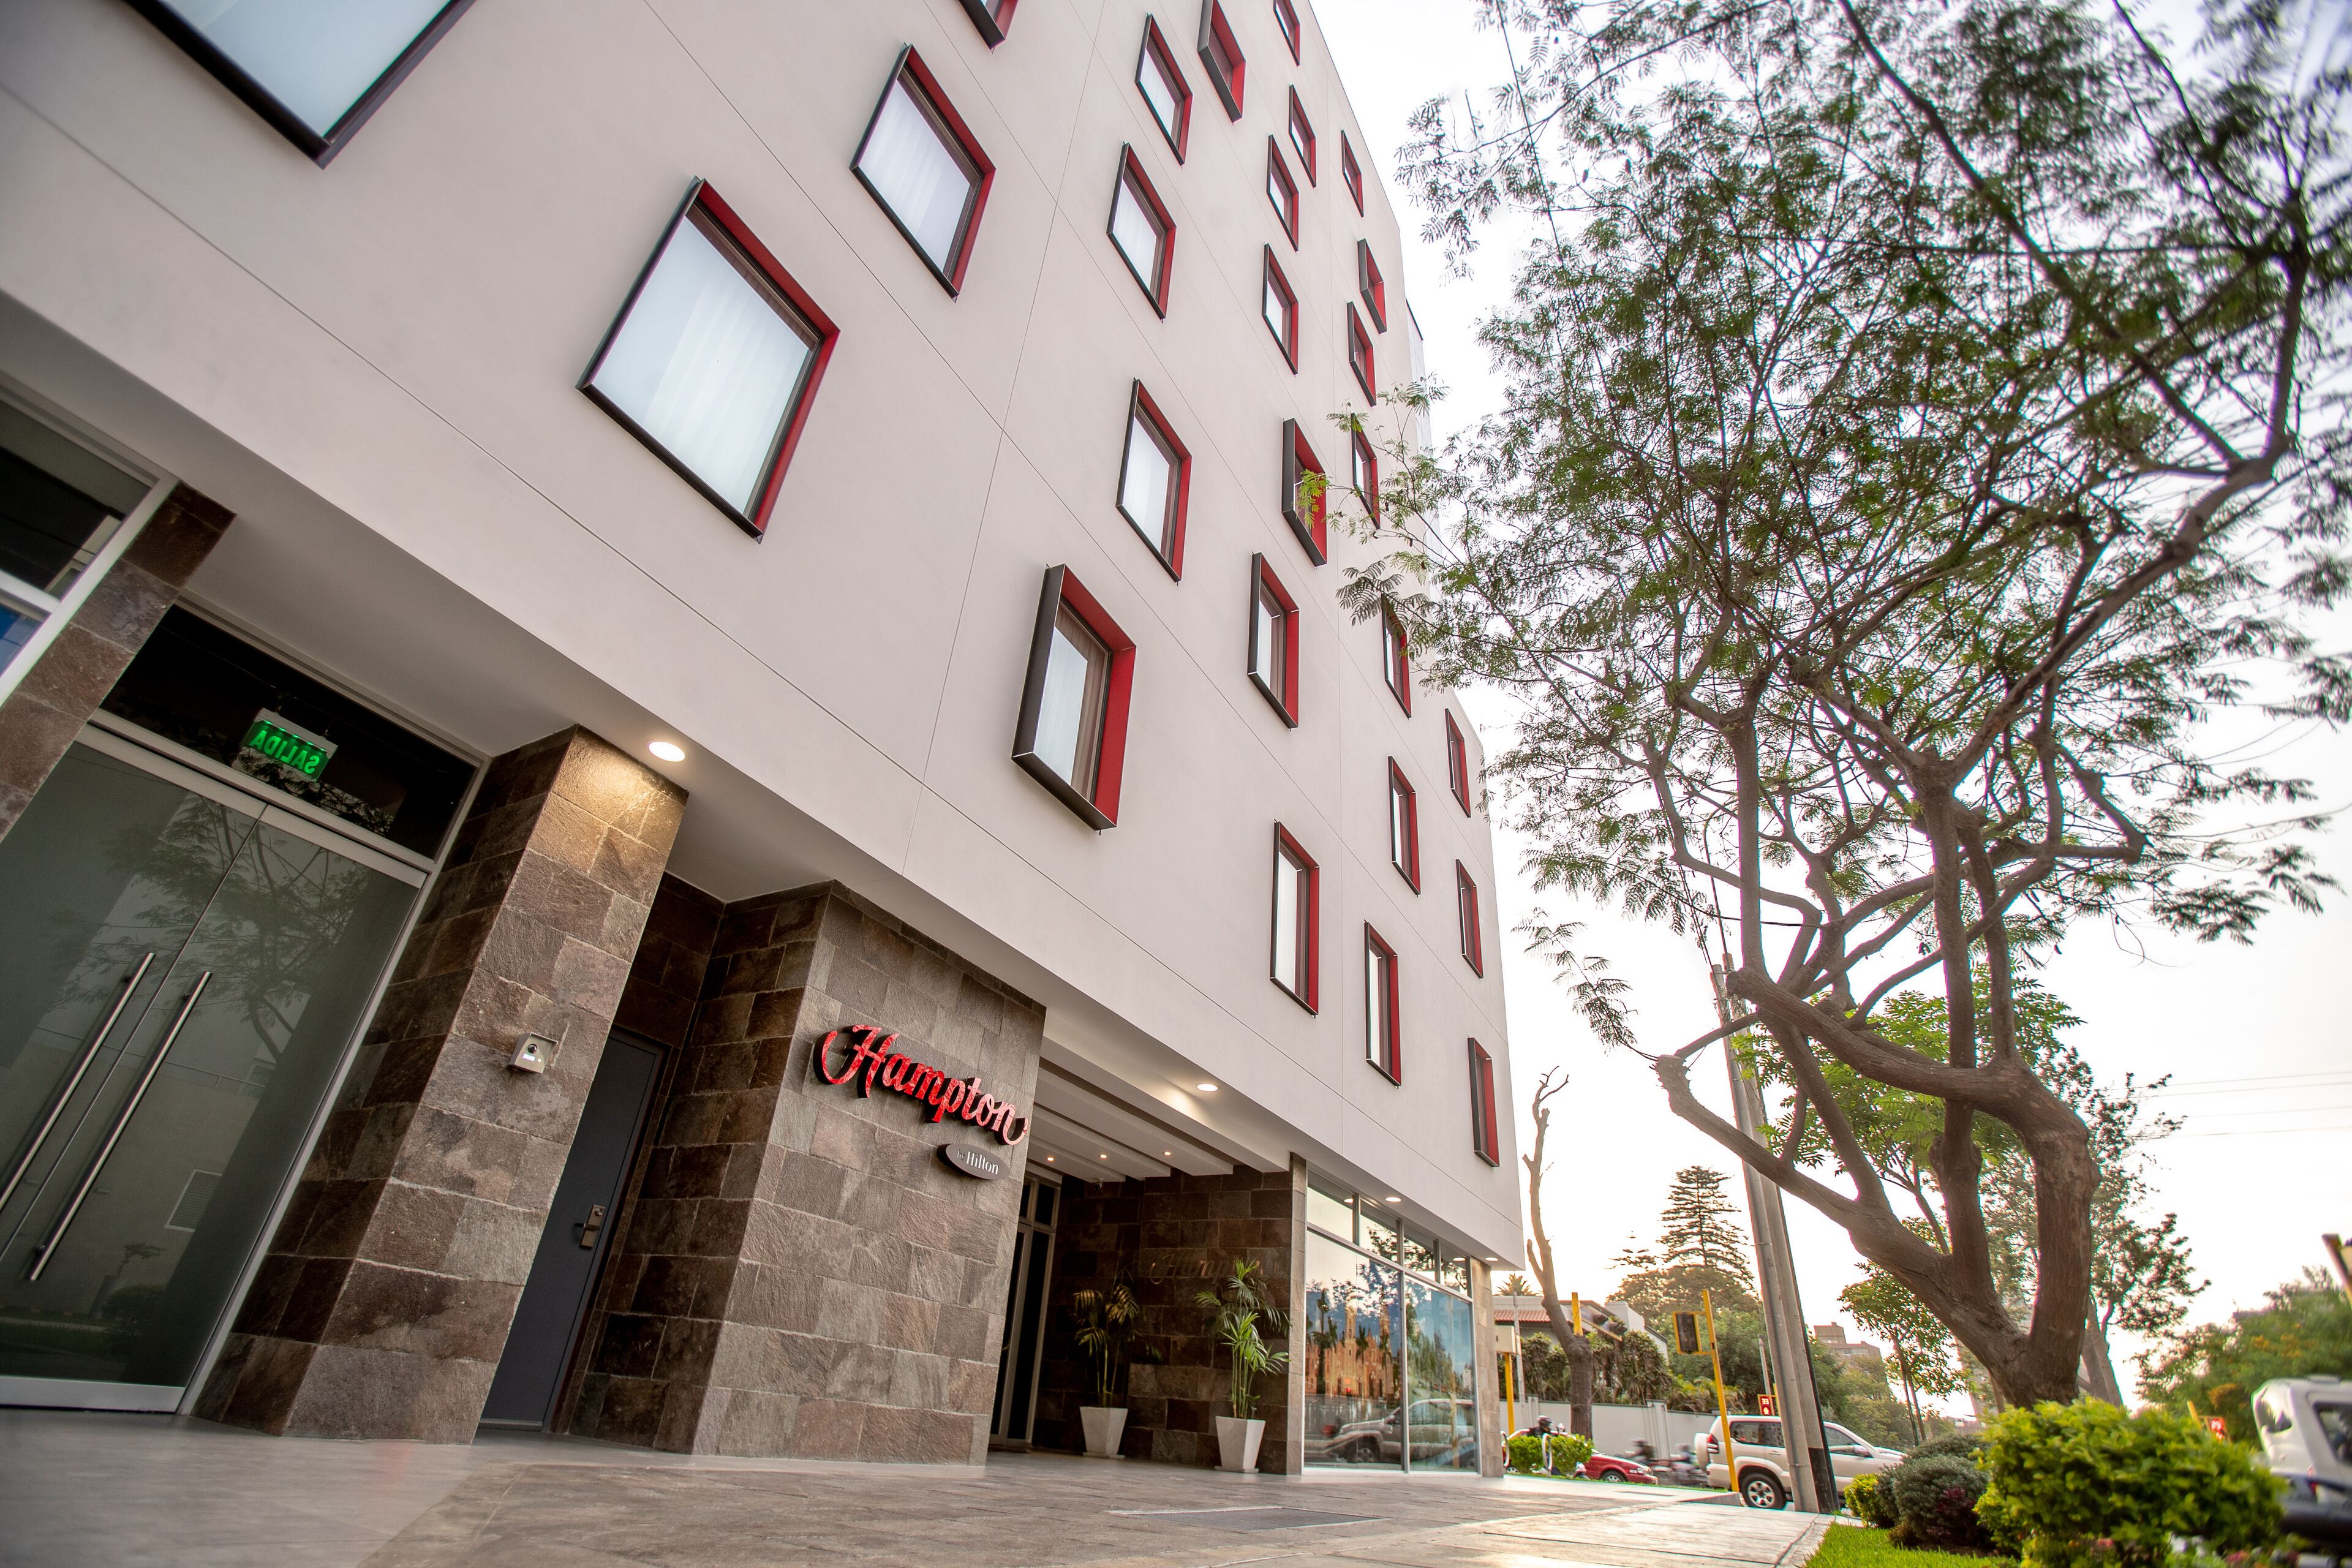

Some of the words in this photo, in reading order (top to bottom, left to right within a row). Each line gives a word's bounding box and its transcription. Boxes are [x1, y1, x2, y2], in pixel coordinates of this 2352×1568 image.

[820, 1023, 1028, 1145] Hampton
[957, 1149, 966, 1161] by
[966, 1151, 999, 1175] Hilton
